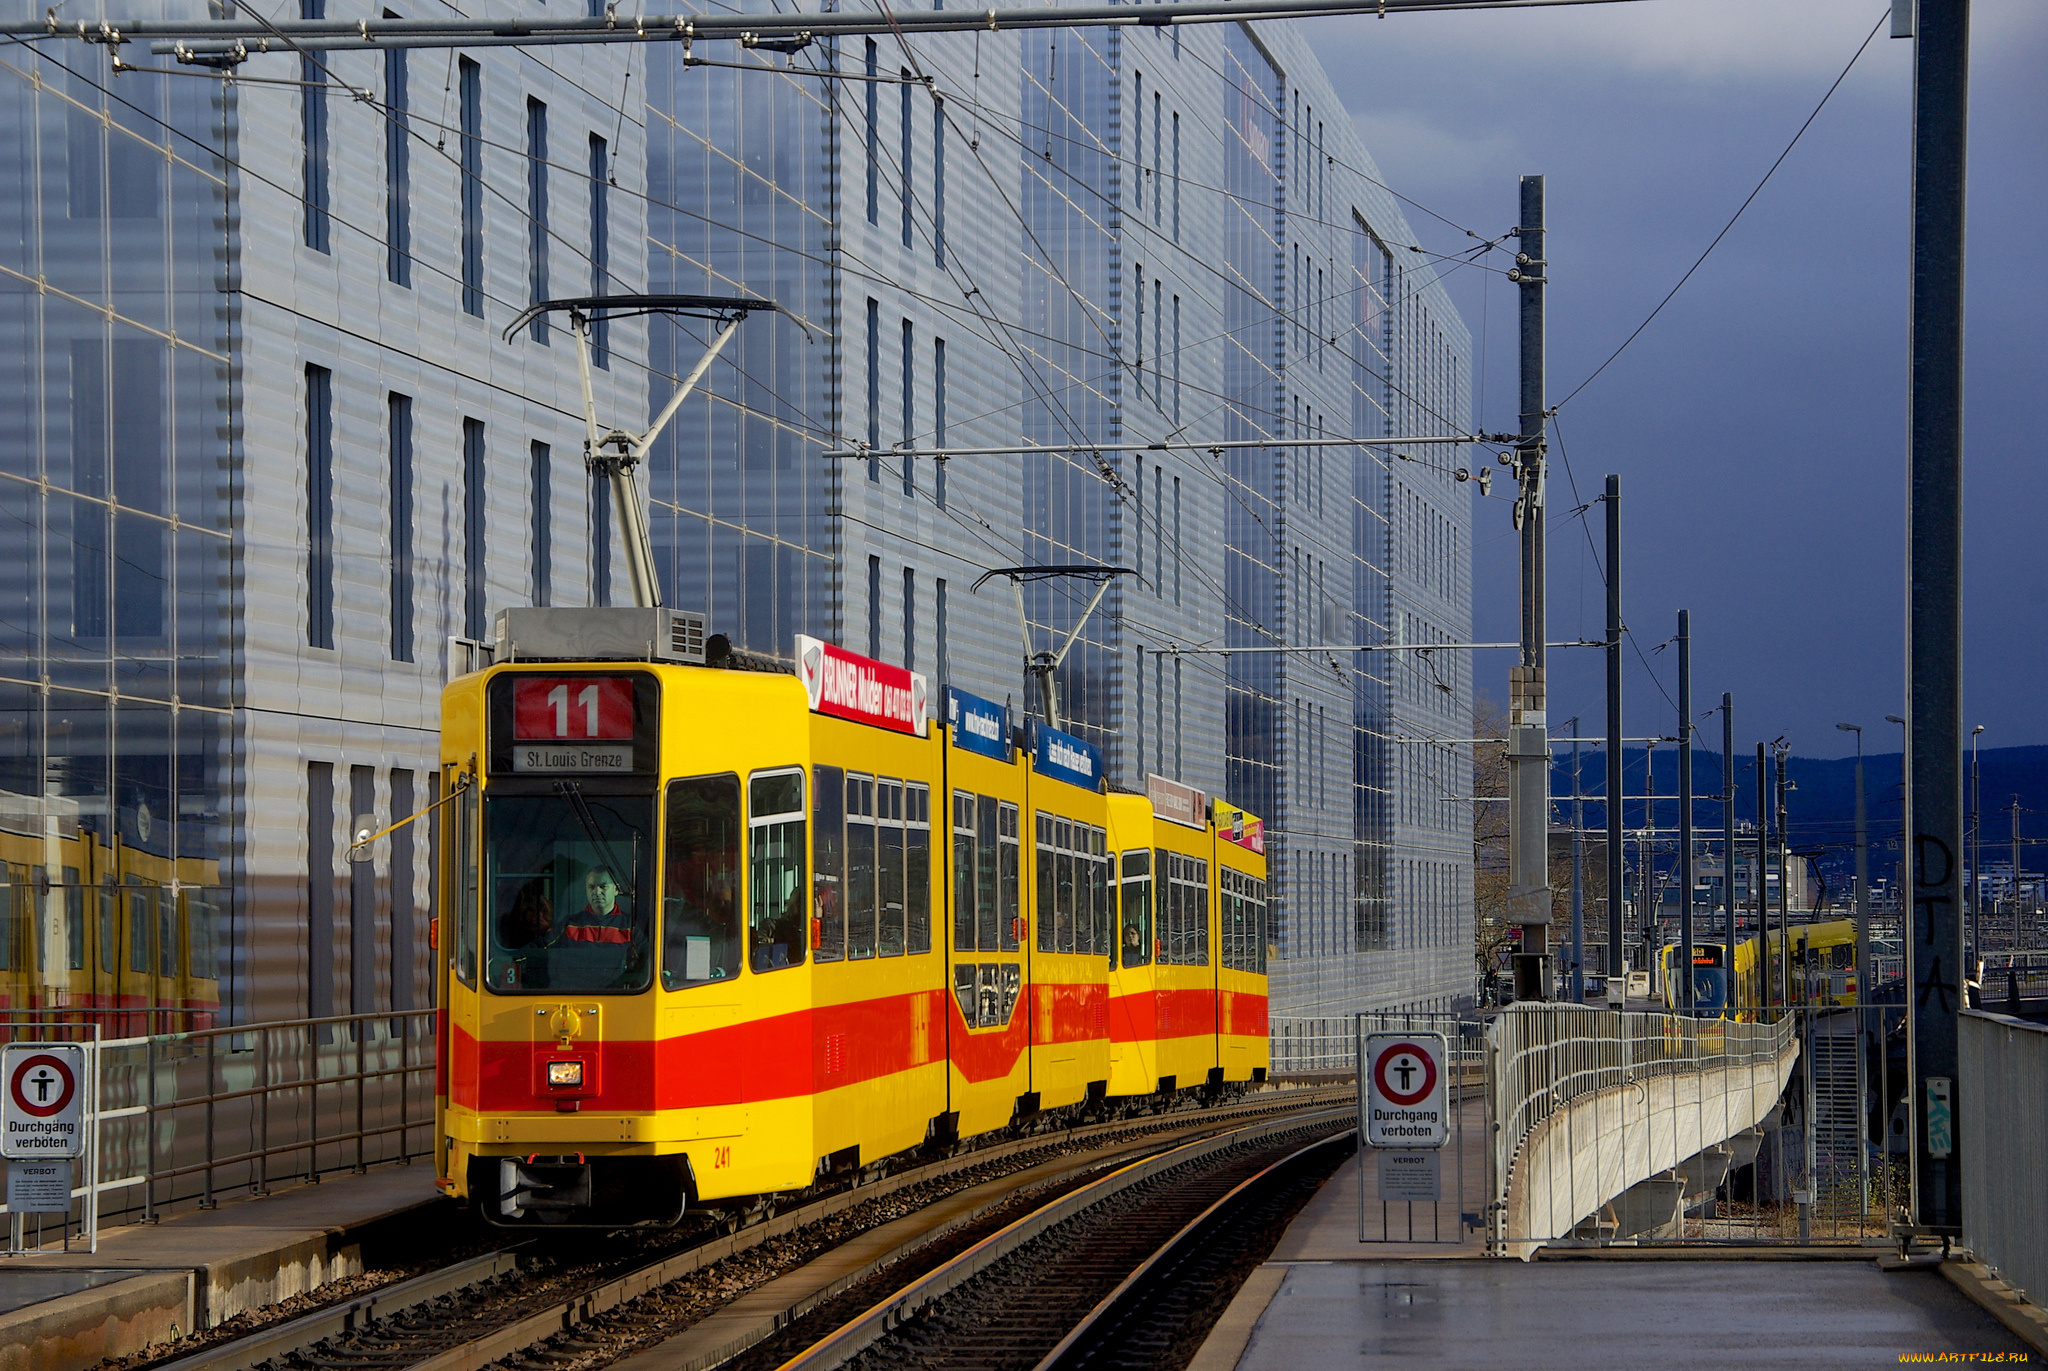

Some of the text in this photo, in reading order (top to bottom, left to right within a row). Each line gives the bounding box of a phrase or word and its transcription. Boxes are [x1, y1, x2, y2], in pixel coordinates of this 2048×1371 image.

[824, 654, 857, 710] BRUNNER
[857, 666, 882, 715] Mulden
[547, 684, 598, 737] 11
[527, 751, 622, 767] St. Louis Grenze
[506, 967, 516, 984] 3
[1374, 1109, 1438, 1123] Durchgang
[1381, 1125, 1432, 1136] verboten
[714, 1145, 730, 1169] 241
